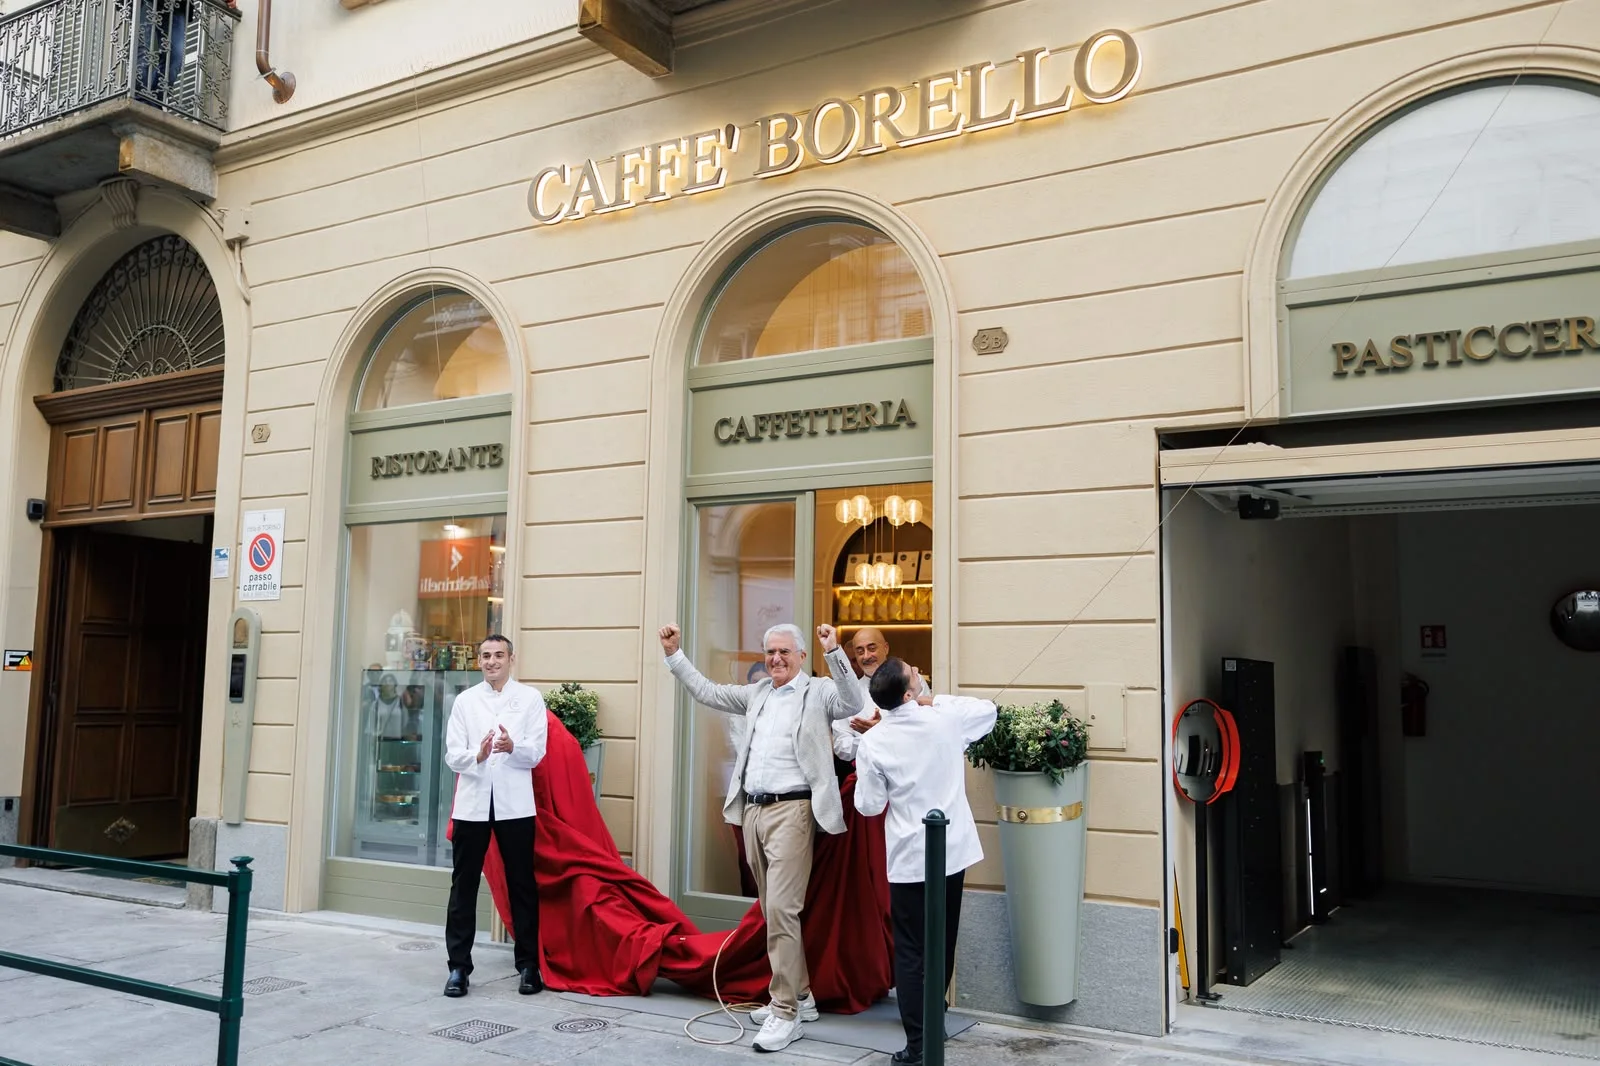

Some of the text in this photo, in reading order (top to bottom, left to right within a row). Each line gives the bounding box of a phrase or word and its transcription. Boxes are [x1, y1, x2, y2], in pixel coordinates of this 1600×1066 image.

[527, 28, 1143, 225] CAFFE' BORELLO
[1331, 316, 1600, 376] PASTICCER
[714, 398, 917, 444] CAFFETTERIA
[370, 443, 504, 480] RISTORANTE
[243, 582, 277, 592] carrabile
[249, 573, 272, 583] passo
